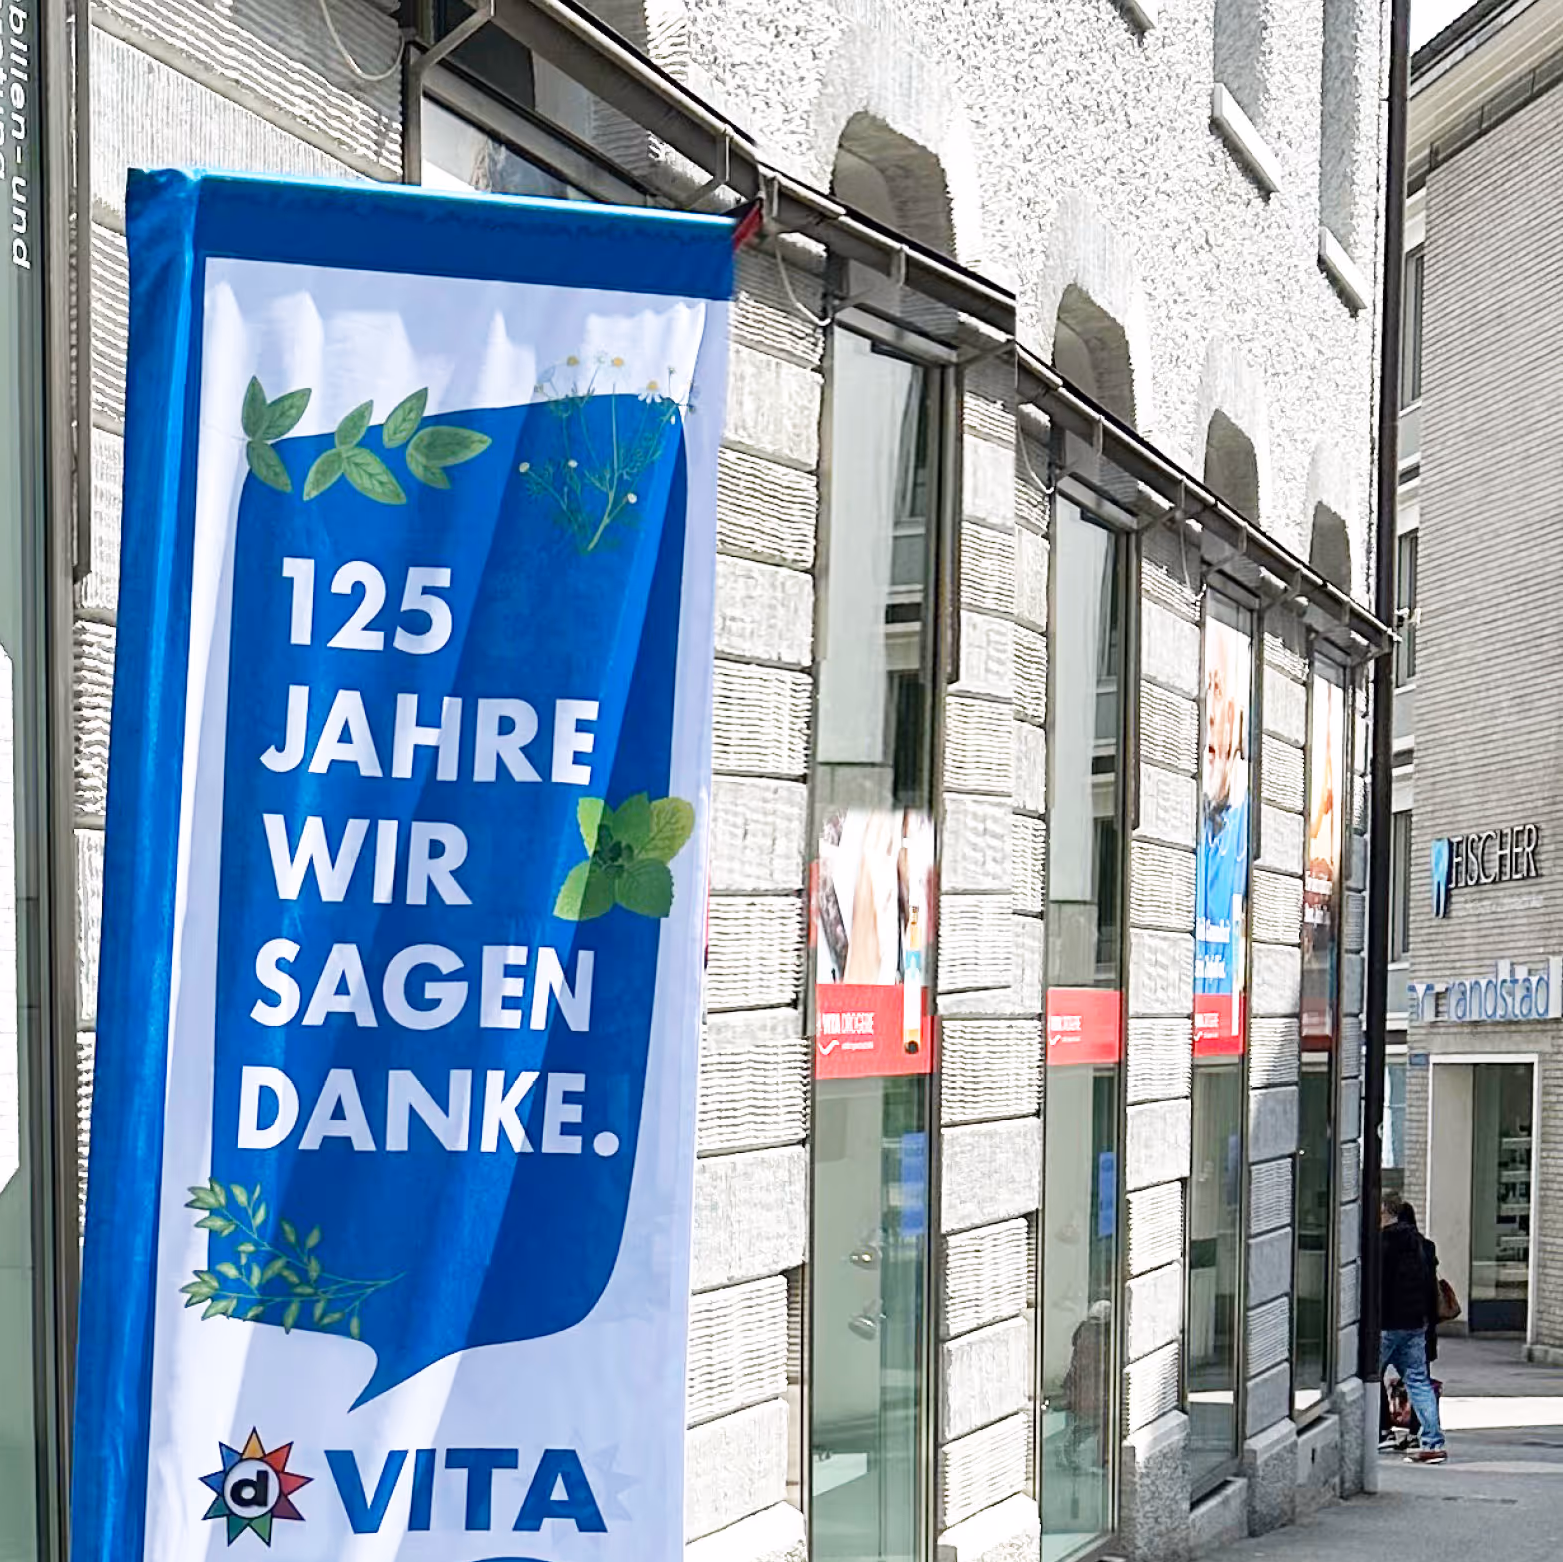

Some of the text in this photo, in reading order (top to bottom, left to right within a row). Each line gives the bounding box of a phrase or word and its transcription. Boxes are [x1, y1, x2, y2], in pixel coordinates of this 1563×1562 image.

[11, 176, 32, 269] und
[282, 556, 453, 656] 125
[259, 684, 600, 786] JAHRE
[263, 813, 472, 906] WIR
[1448, 823, 1540, 888] FISCHER
[249, 937, 595, 1032] SAGEN
[1448, 956, 1557, 1021] randstad
[237, 1065, 620, 1158] DANKE.
[324, 1447, 609, 1534] VITA
